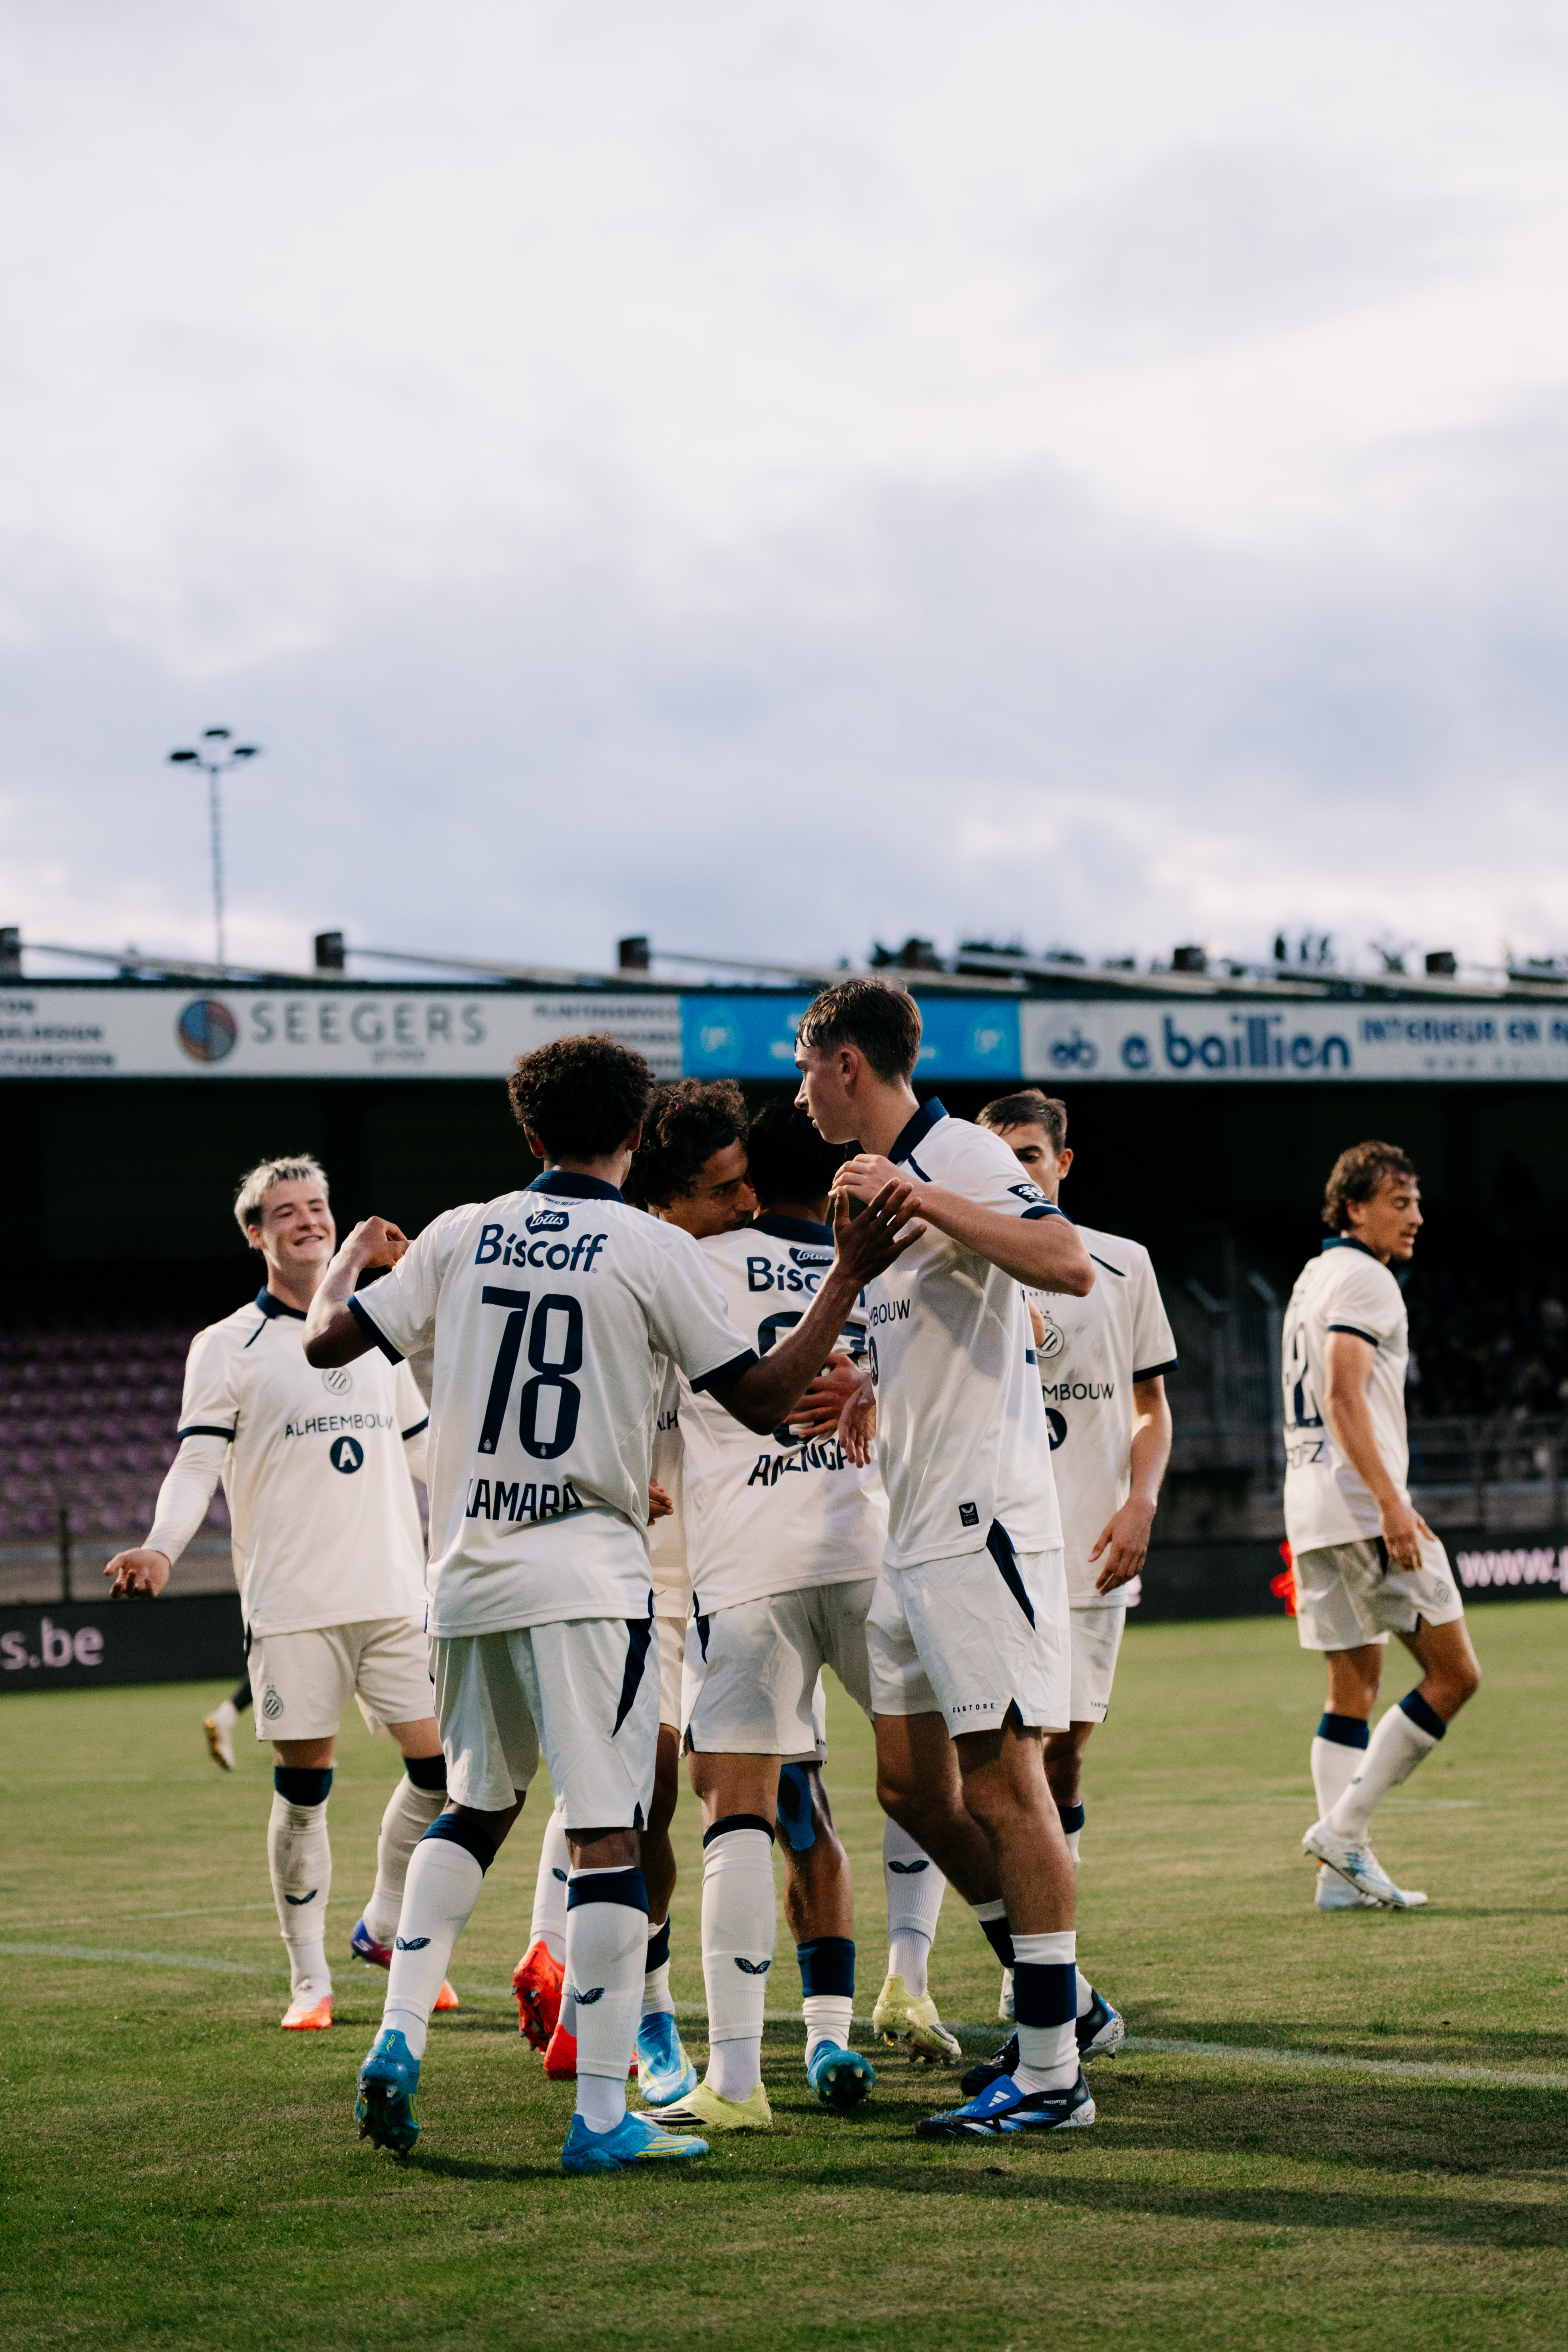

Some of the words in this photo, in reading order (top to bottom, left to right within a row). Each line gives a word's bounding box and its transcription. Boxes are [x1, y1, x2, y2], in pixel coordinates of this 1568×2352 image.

[251, 1000, 486, 1044] SEEGERS
[1164, 1013, 1351, 1070] baillien
[530, 1212, 565, 1227] Lotus
[475, 1224, 608, 1272] Biscoff
[478, 1286, 583, 1460] 78
[1042, 1383, 1114, 1401] MBOUW
[466, 1478, 584, 1522] AMARA
[0, 1616, 104, 1670] s.be
[952, 1703, 994, 1713] CASTORE
[386, 2034, 395, 2052] F50
